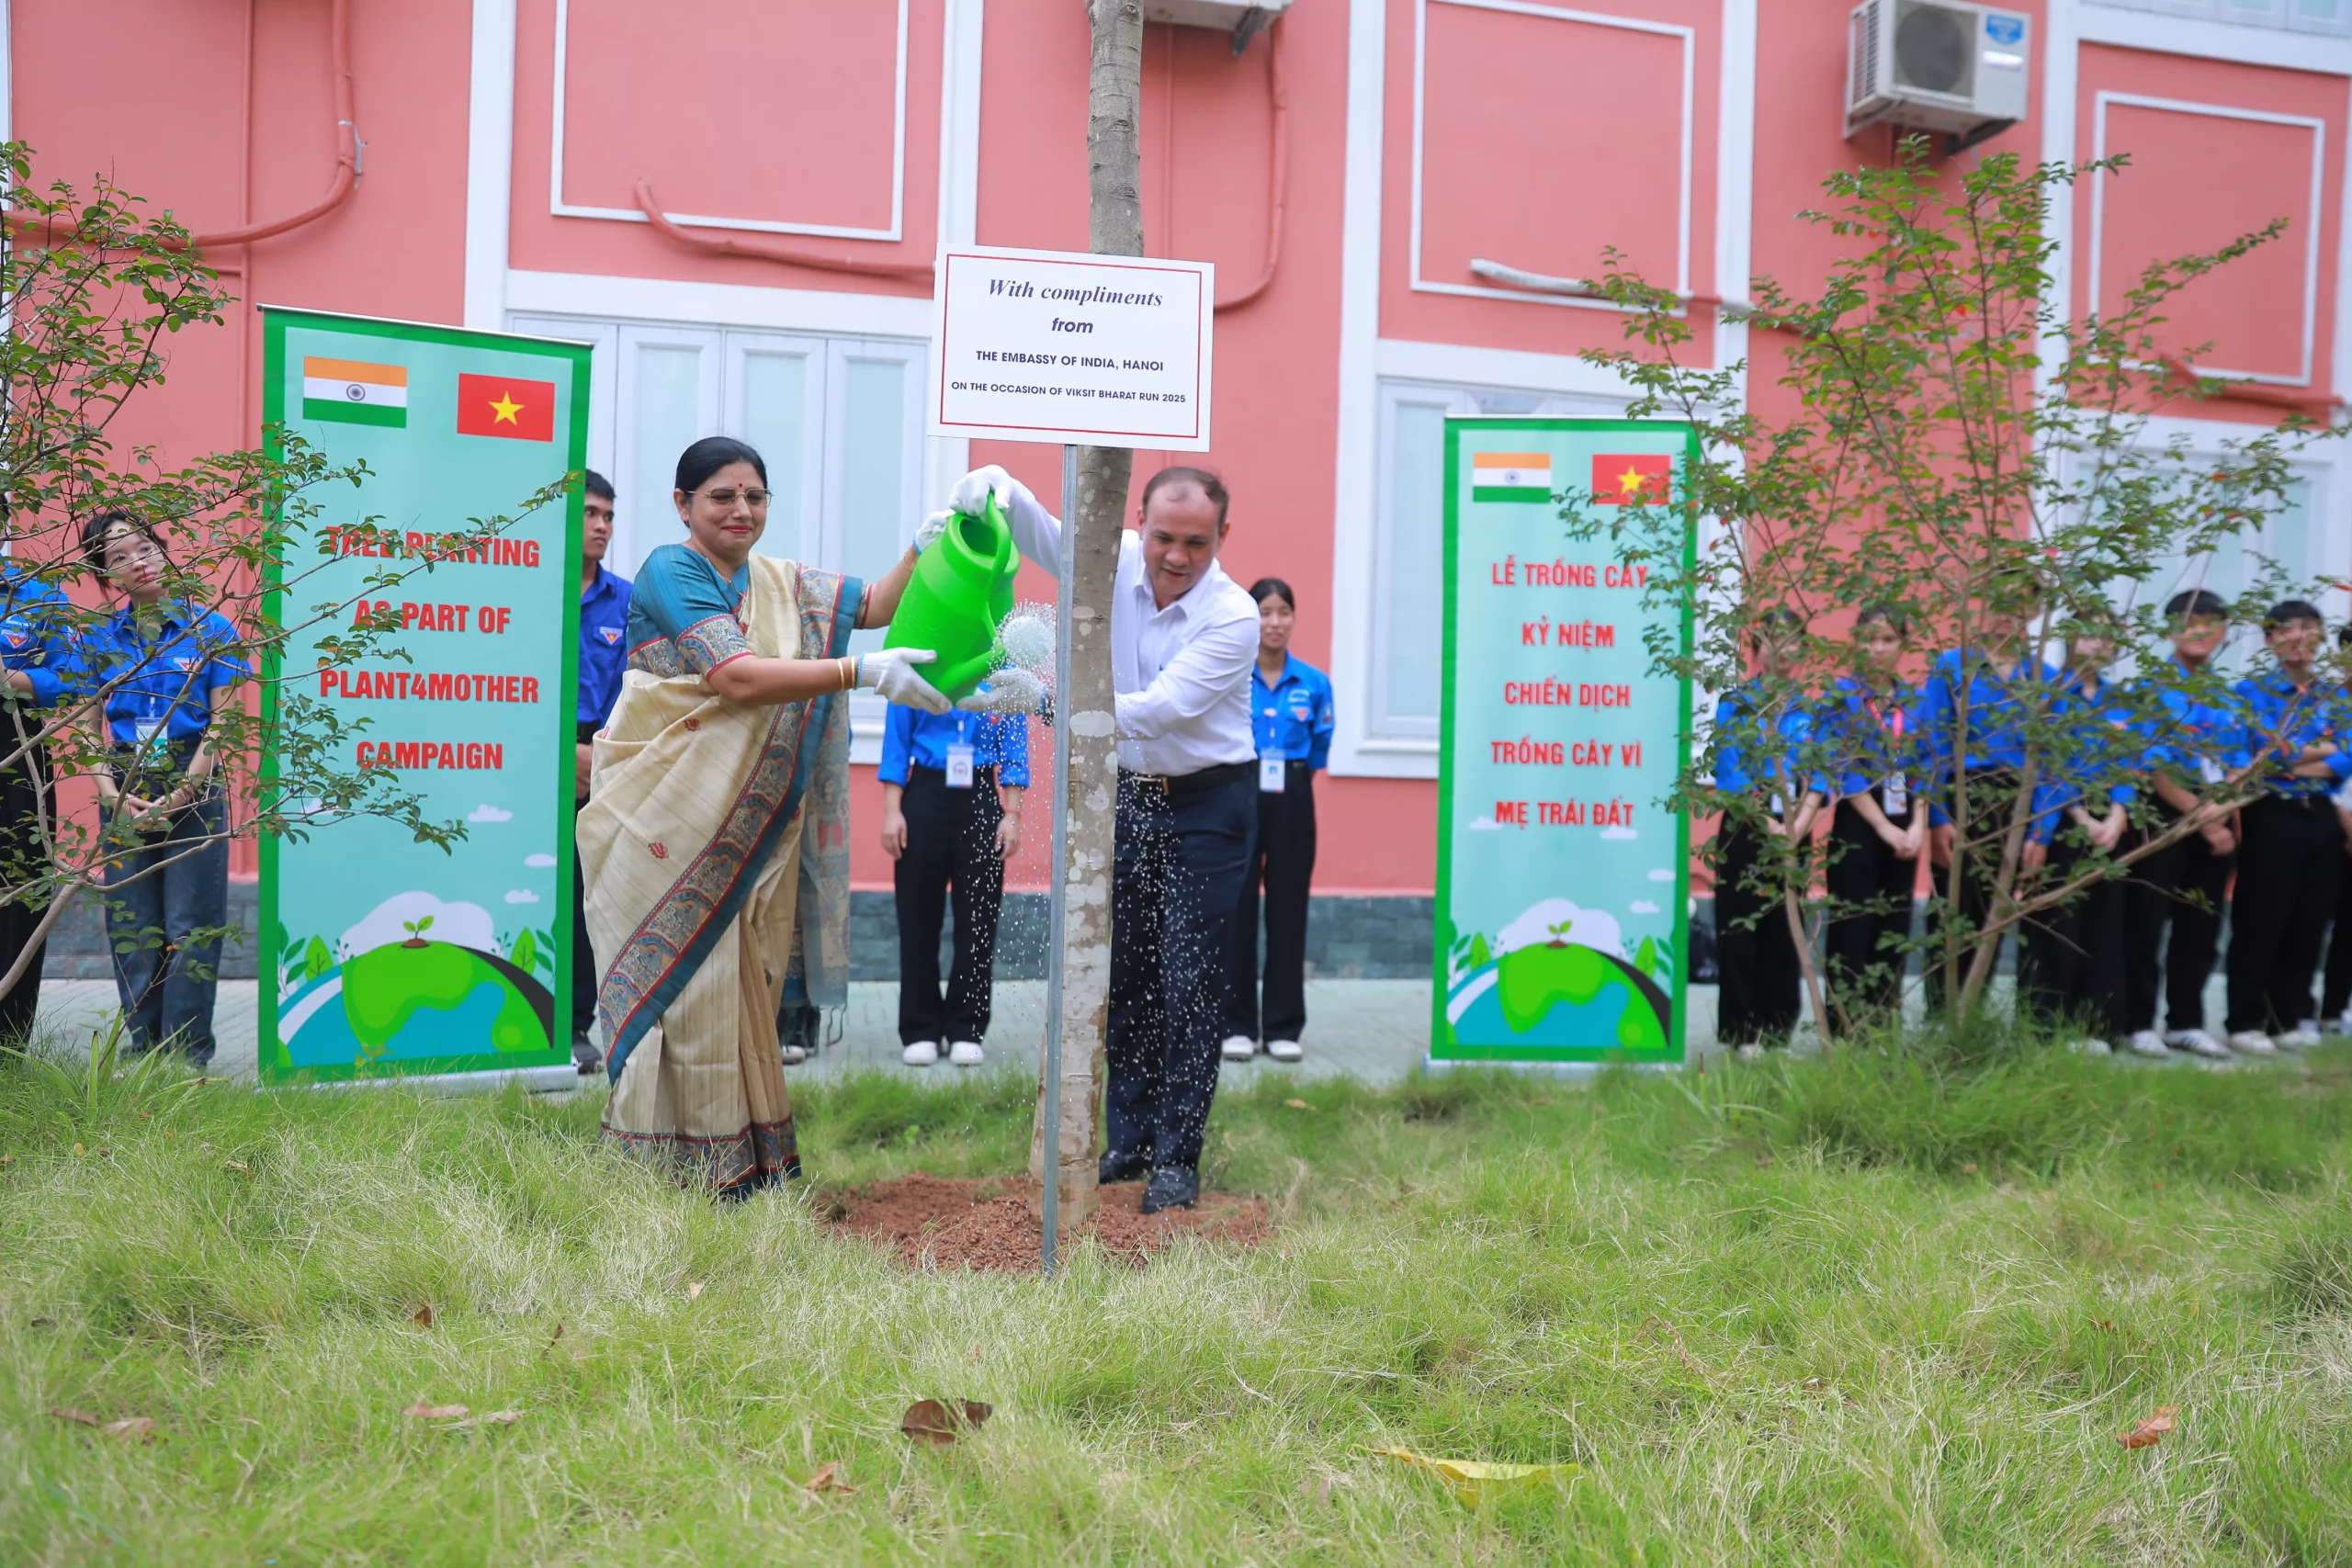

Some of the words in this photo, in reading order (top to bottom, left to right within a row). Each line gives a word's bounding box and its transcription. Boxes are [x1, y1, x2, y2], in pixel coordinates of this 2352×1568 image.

[989, 278, 1035, 299] With
[1040, 286, 1163, 307] compliments
[1051, 317, 1094, 334] from
[976, 350, 998, 362] THE
[1001, 352, 1057, 365] EMBASSY
[1060, 355, 1078, 367] OF
[1080, 356, 1119, 371] INDIA,
[1123, 359, 1164, 372] HANOI
[951, 381, 967, 390] ON
[969, 382, 988, 391] THE
[989, 383, 1046, 395] OCCASION
[1048, 387, 1063, 396] OF
[1065, 388, 1096, 398] VIKSIT
[1098, 389, 1136, 400] BHARAT
[1139, 392, 1159, 401] RUN
[1161, 393, 1186, 403] 2025
[401, 602, 469, 631] PART
[478, 605, 511, 634] OF
[1522, 615, 1550, 645] KỶ
[1558, 619, 1614, 651] NIỆM
[320, 669, 539, 703] PLANT4MOTHER
[1504, 675, 1571, 705] CHIẾN
[1579, 683, 1630, 712] DỊCH
[356, 741, 503, 769] CAMPAIGN
[1571, 739, 1613, 766] CÂY
[1621, 740, 1641, 767] VÌ
[1495, 800, 1528, 829] MẸ
[1537, 797, 1585, 826] TRÁI
[1592, 795, 1634, 826] ĐẤT
